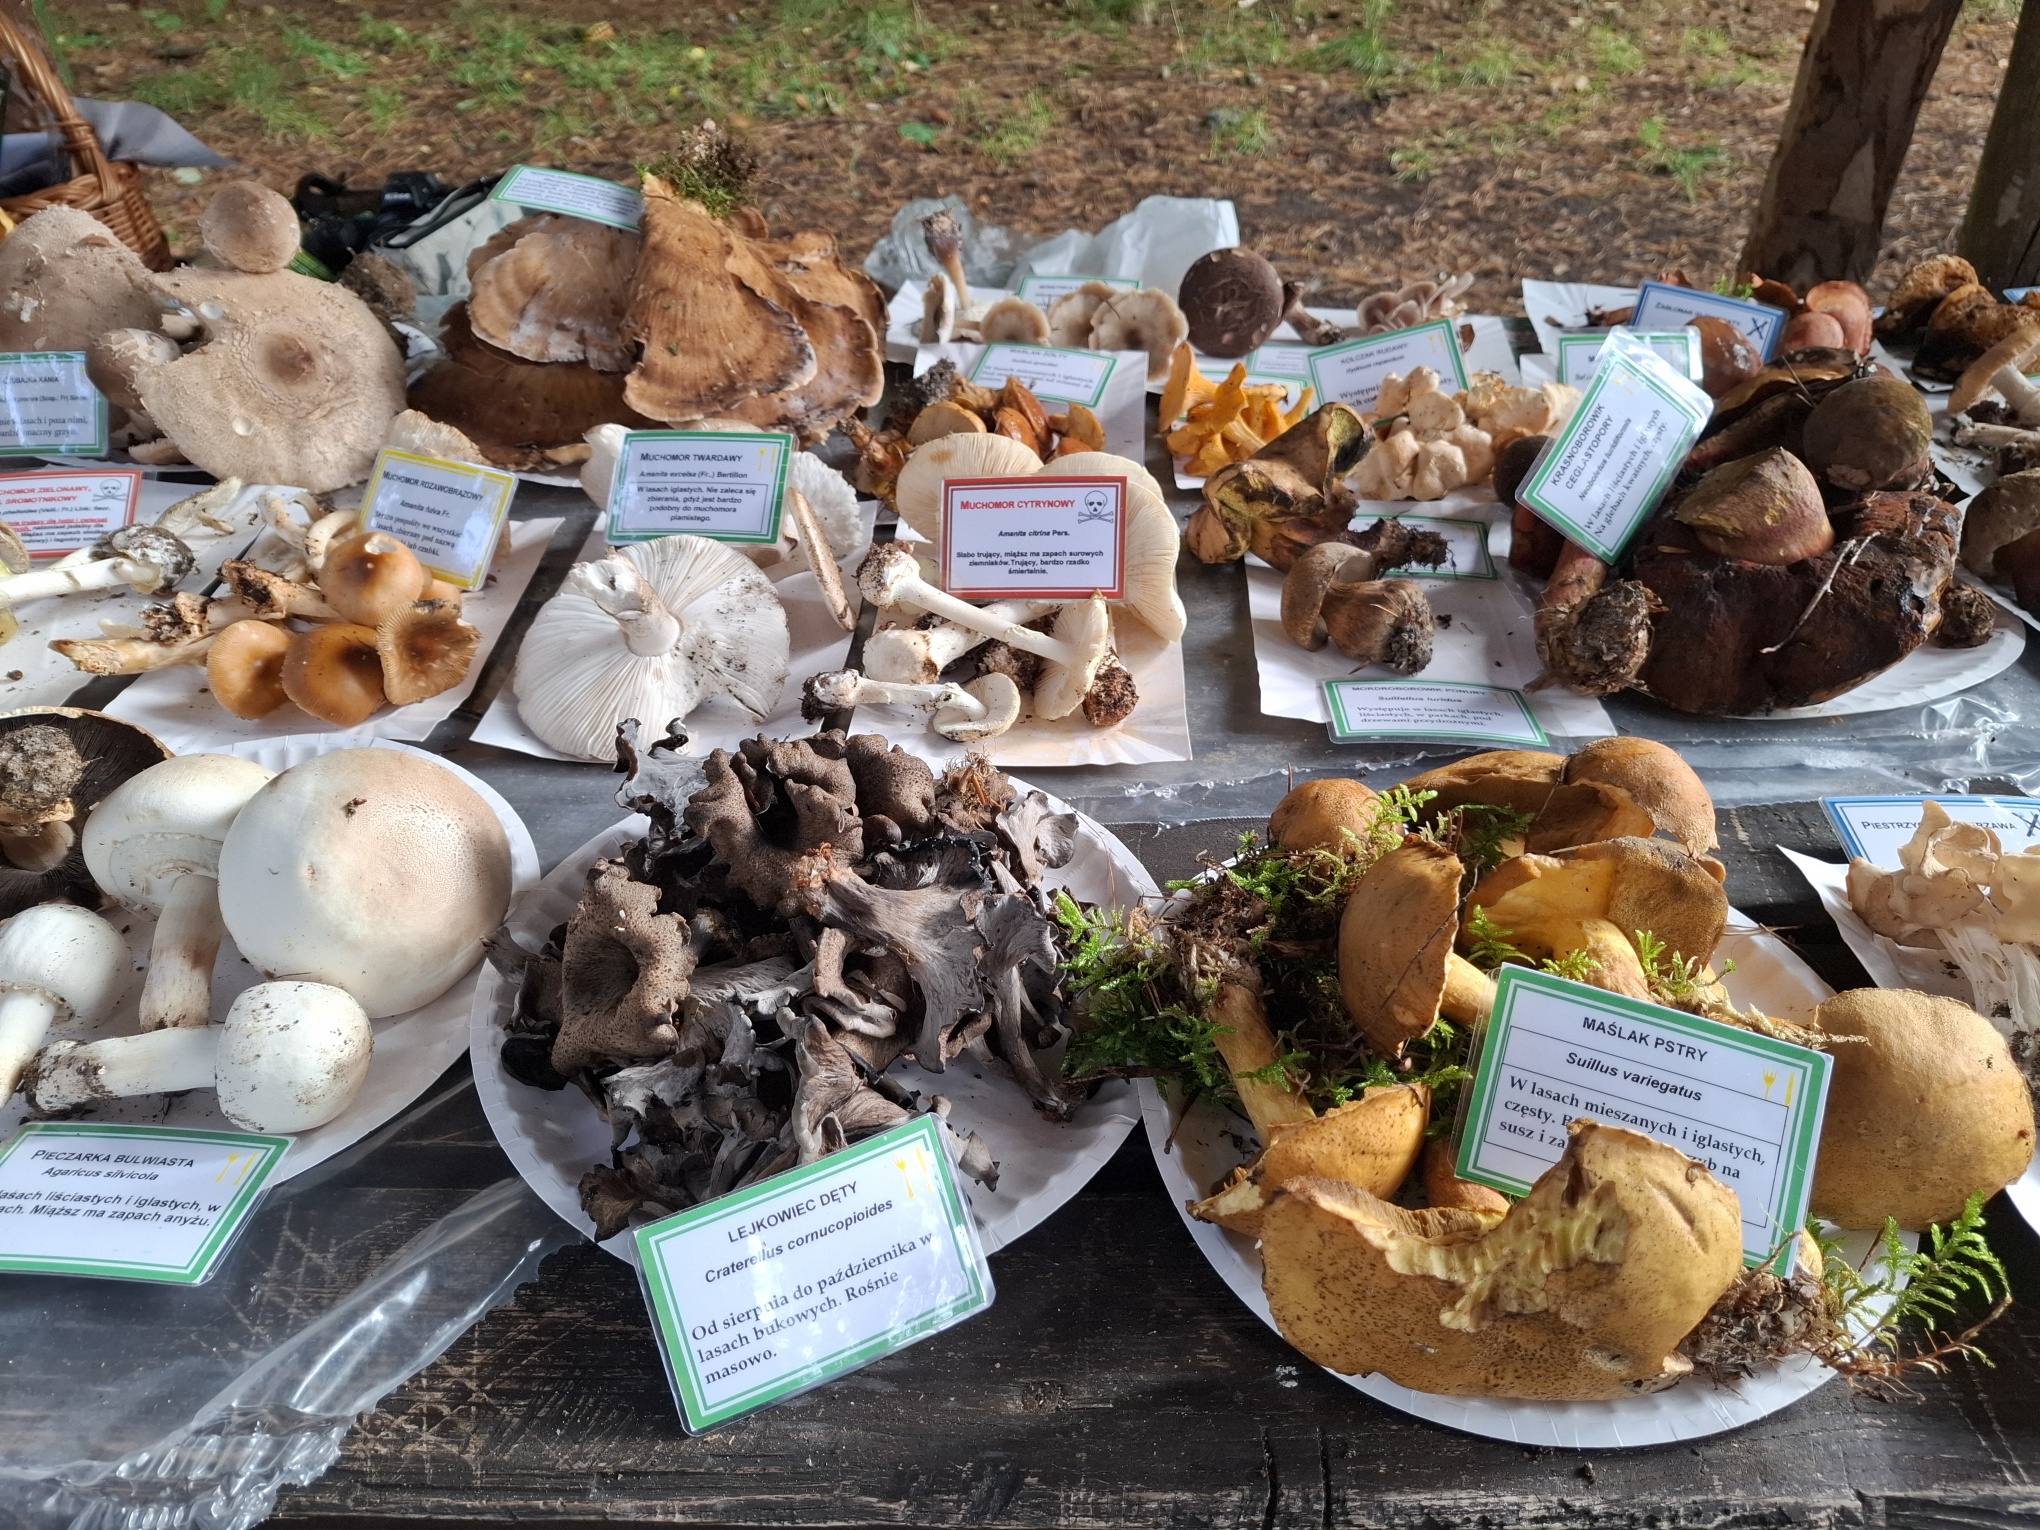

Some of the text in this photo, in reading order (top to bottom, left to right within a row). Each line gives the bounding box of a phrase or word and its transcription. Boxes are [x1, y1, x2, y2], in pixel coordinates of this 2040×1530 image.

[1340, 383, 1381, 400] Występuj
[1550, 403, 1605, 486] KRASNOBOROWIK
[1565, 414, 1614, 490] CEGLASTOPORY
[640, 453, 743, 462] MUCHOMOR TWARDAWY
[382, 470, 484, 502] MUCHOMOR RDZAWOBRĄZOWY
[745, 488, 757, 496] się
[649, 505, 681, 513] podobny
[693, 505, 737, 513] muchomora
[700, 496, 715, 504] jest
[716, 496, 743, 504] bardzo
[960, 499, 1076, 510] MUCHOMOR CYTRYNOWY
[670, 515, 712, 523] plamistego.
[1052, 529, 1071, 537] Pers.
[977, 551, 1002, 559] trujący,
[1042, 550, 1067, 559] zapach
[1069, 550, 1104, 559] surowych
[1066, 558, 1090, 566] rzadko
[1008, 567, 1049, 575] śmiertelnie.
[1582, 1016, 1708, 1063] MAŚLAK PSTRY
[1565, 1051, 1703, 1101] Suillus variegatus
[1503, 1098, 1556, 1125] częsty.
[1509, 1075, 1528, 1091] W
[1531, 1081, 1579, 1108] lasach
[1584, 1100, 1677, 1138] mieszanych
[1681, 1126, 1689, 1141] i
[1691, 1129, 1766, 1165] iglastych,
[1498, 1121, 1545, 1143] susz i
[30, 1149, 194, 1168] PIECZARKA BULWIASTA
[41, 1166, 159, 1181] Agaricus silvicola
[1722, 1165, 1741, 1179] na
[44, 1191, 122, 1206] liściastych
[125, 1195, 133, 1205] i
[133, 1196, 202, 1212] iglastych,
[207, 1204, 222, 1212] w
[728, 1181, 858, 1243] LEJKOWIEC DĘTY
[29, 1204, 82, 1218] Miąższ
[82, 1208, 106, 1218] ma
[107, 1210, 162, 1222] zapach
[163, 1214, 211, 1227] anyżu.
[705, 1199, 894, 1283] Craterellus cornucopioides
[691, 1232, 934, 1342] Od sierpnia do października w
[697, 1270, 900, 1364] lasach bukowych. Rośnie
[704, 1349, 778, 1385] masowo.
